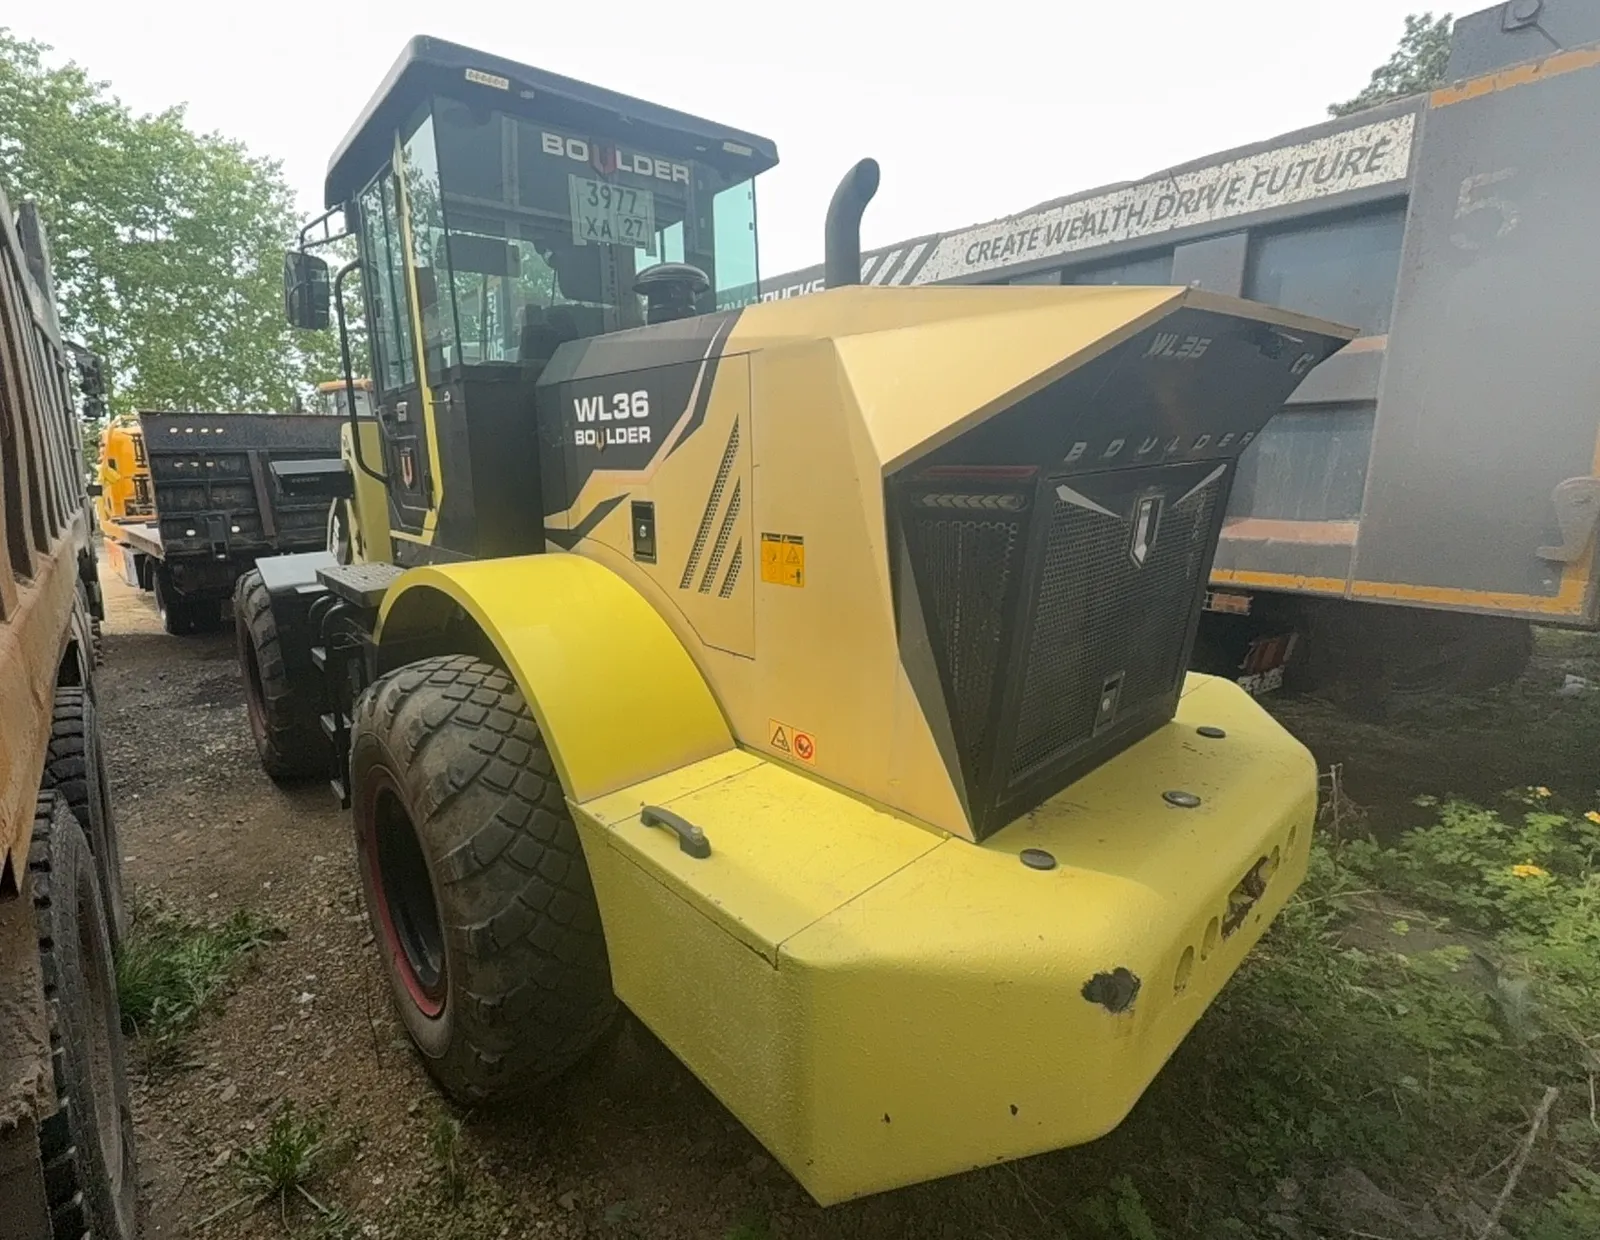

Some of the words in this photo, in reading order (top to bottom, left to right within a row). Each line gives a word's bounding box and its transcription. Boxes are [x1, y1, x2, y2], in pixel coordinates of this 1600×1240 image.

[541, 131, 689, 185] BOULDER
[586, 181, 637, 214] 3977
[965, 226, 1044, 265] CREATE
[1248, 136, 1391, 201] FUTURE
[623, 218, 643, 238] 27
[752, 278, 825, 304] RUCKS
[573, 390, 650, 422] WL36
[574, 426, 651, 452] BOULDER
[1063, 432, 1254, 462] BOULDER
